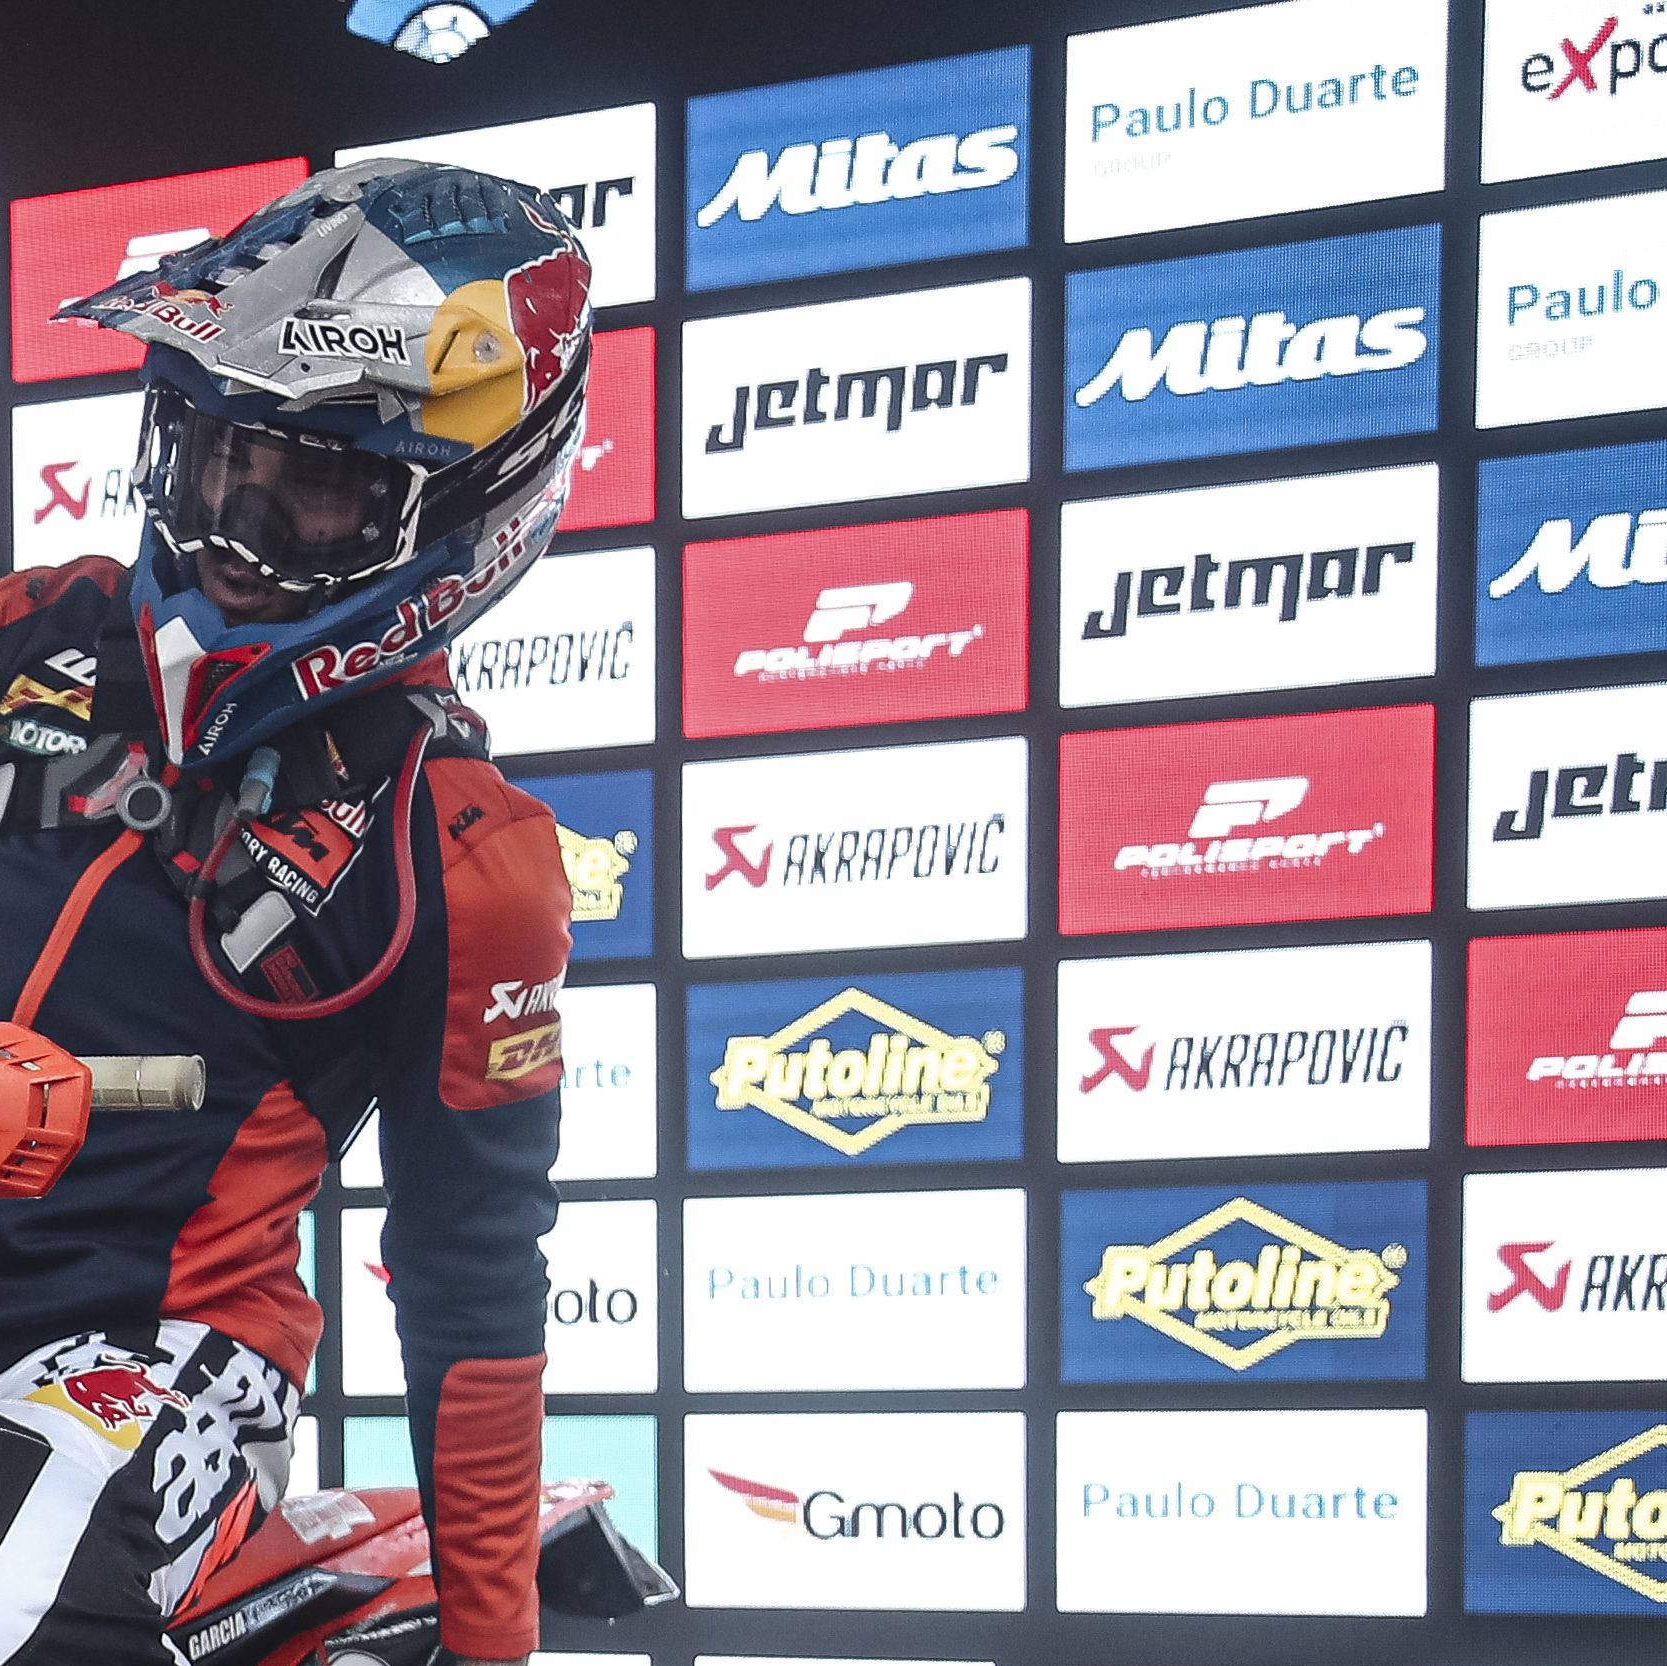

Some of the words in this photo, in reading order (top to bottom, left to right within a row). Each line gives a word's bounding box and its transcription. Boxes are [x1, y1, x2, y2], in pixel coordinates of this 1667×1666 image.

[1090, 83, 1229, 142] Paulo
[1249, 62, 1420, 119] Duarte
[698, 124, 1019, 230] Mitas
[152, 301, 226, 343] Bull
[1507, 269, 1658, 327] Paulo
[279, 318, 411, 366] AIROH
[1076, 307, 1426, 408] Mitas
[395, 440, 452, 458] AIROH
[293, 599, 422, 701] Red
[733, 631, 975, 677] POLISPORT
[197, 701, 238, 757] AIROH
[1113, 828, 1375, 872] POLISPORT
[268, 856, 320, 905] RACING
[726, 1033, 980, 1104] Putoline
[709, 1264, 829, 1301] Paulo
[851, 1264, 999, 1299] Duarte
[1100, 1244, 1381, 1314] Putoline
[802, 1488, 1007, 1541] Gmoto
[1083, 1481, 1216, 1520] Paulo
[1235, 1483, 1399, 1520] Duarte
[188, 1610, 247, 1662] GARCIA
